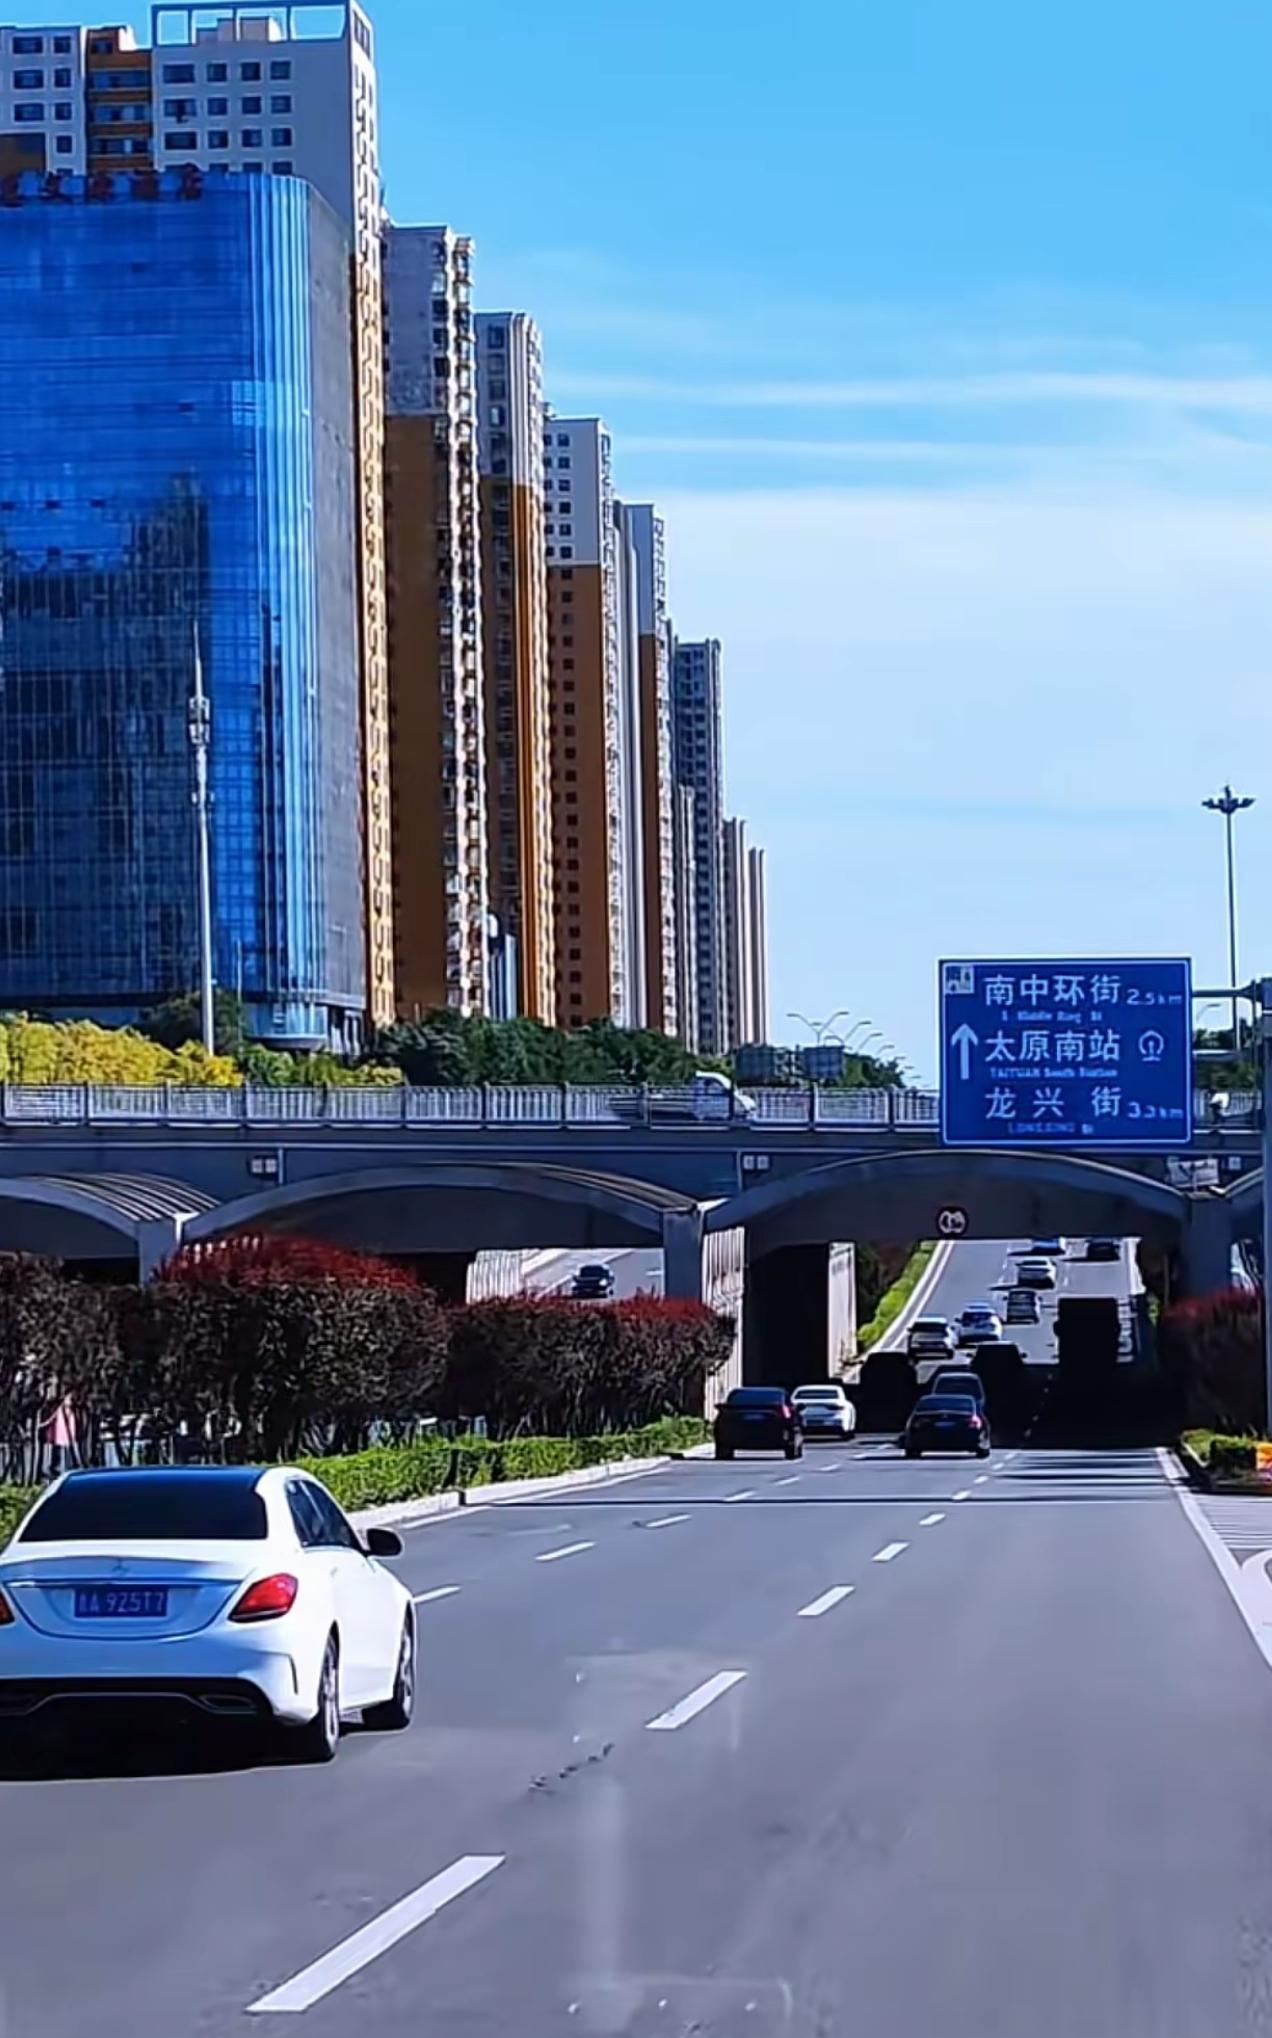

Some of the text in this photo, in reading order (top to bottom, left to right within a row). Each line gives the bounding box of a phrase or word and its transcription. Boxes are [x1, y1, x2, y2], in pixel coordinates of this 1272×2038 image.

[984, 974, 1121, 1007] 南中环街
[984, 1028, 1121, 1063] 太原南站
